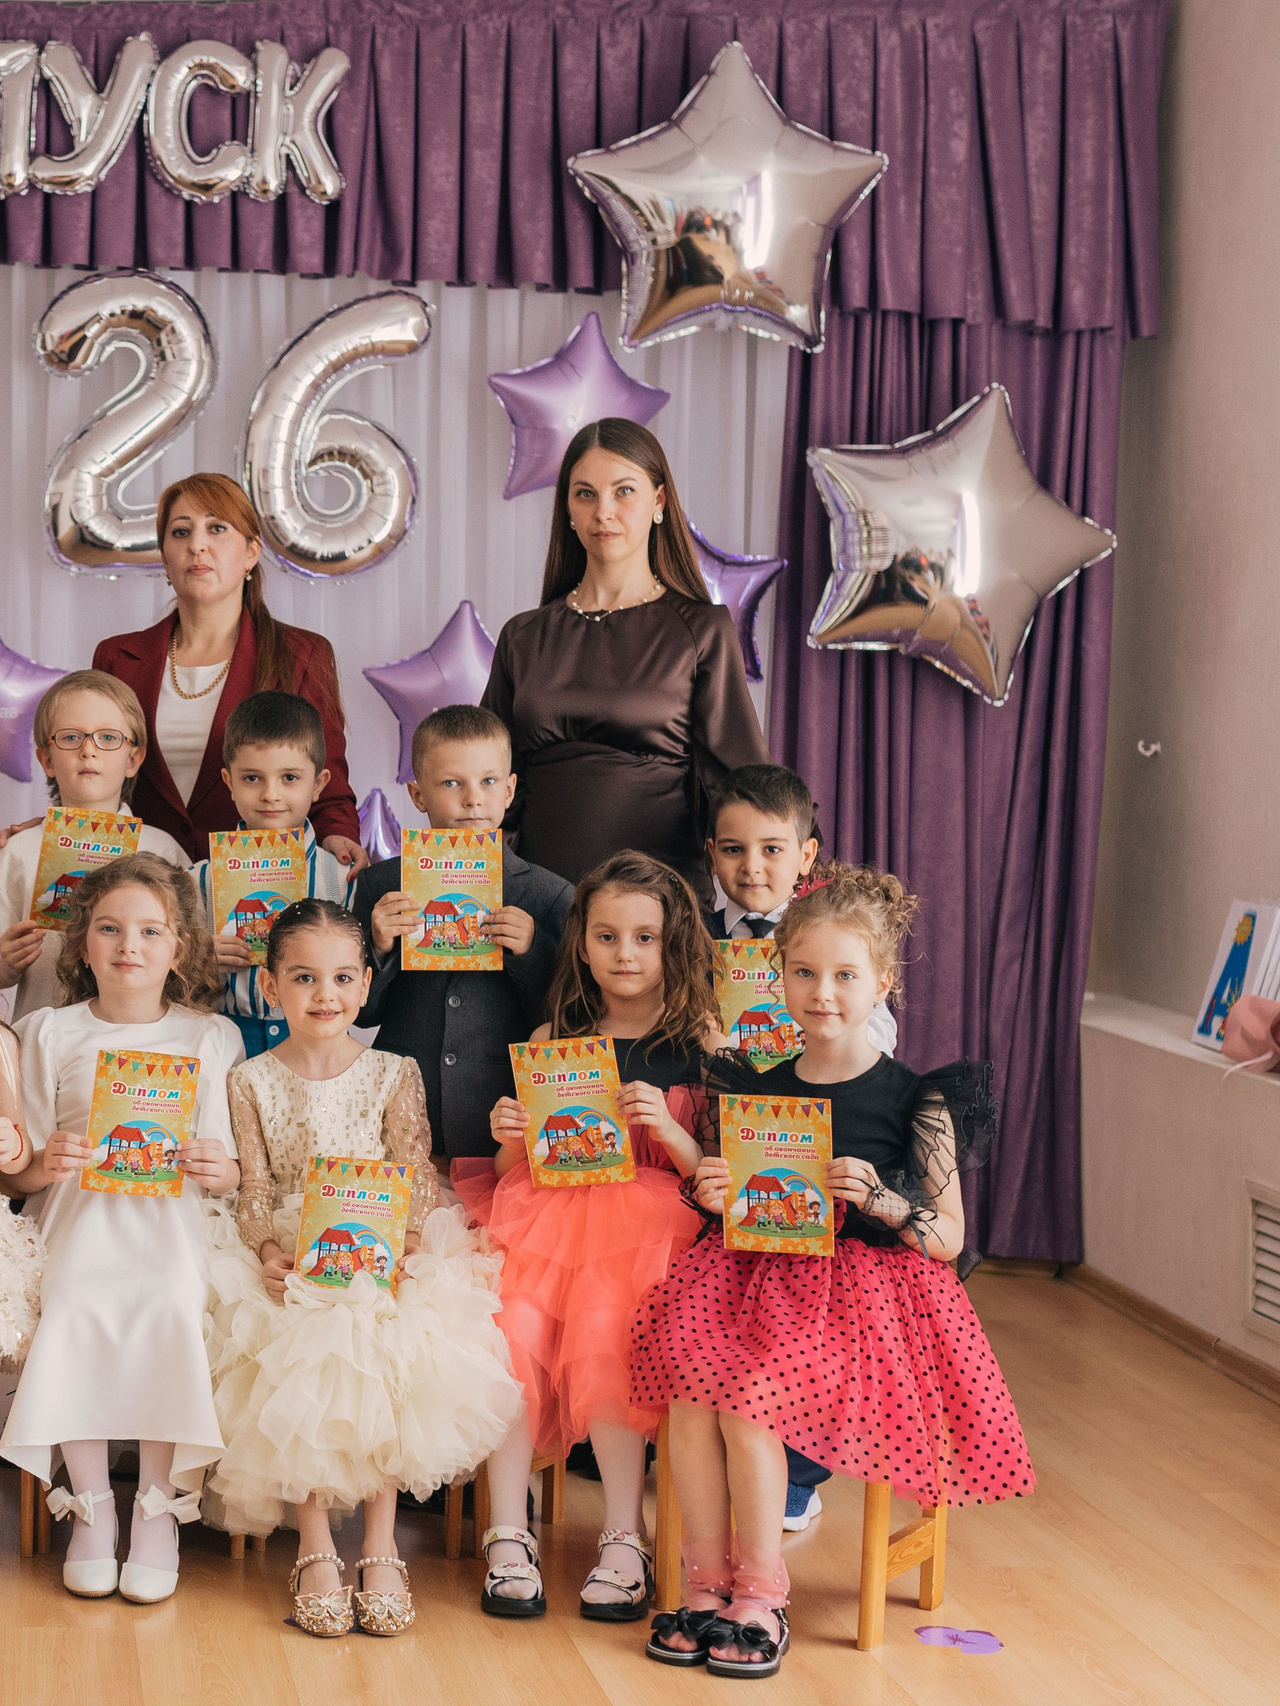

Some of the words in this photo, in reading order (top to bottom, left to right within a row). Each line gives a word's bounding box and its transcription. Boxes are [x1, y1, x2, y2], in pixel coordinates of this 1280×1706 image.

[60, 837, 122, 854] Диплом
[228, 858, 290, 870] Диплом
[420, 858, 485, 870] Диплом
[732, 969, 782, 980] Дипл
[532, 1070, 600, 1084] Диплом
[112, 1082, 180, 1099] Диплом
[566, 1083, 604, 1091] окончании
[740, 1128, 812, 1144] Диплом
[322, 1185, 390, 1202] Диплом
[341, 1208, 376, 1216] детского
[352, 1204, 392, 1212] окончании
